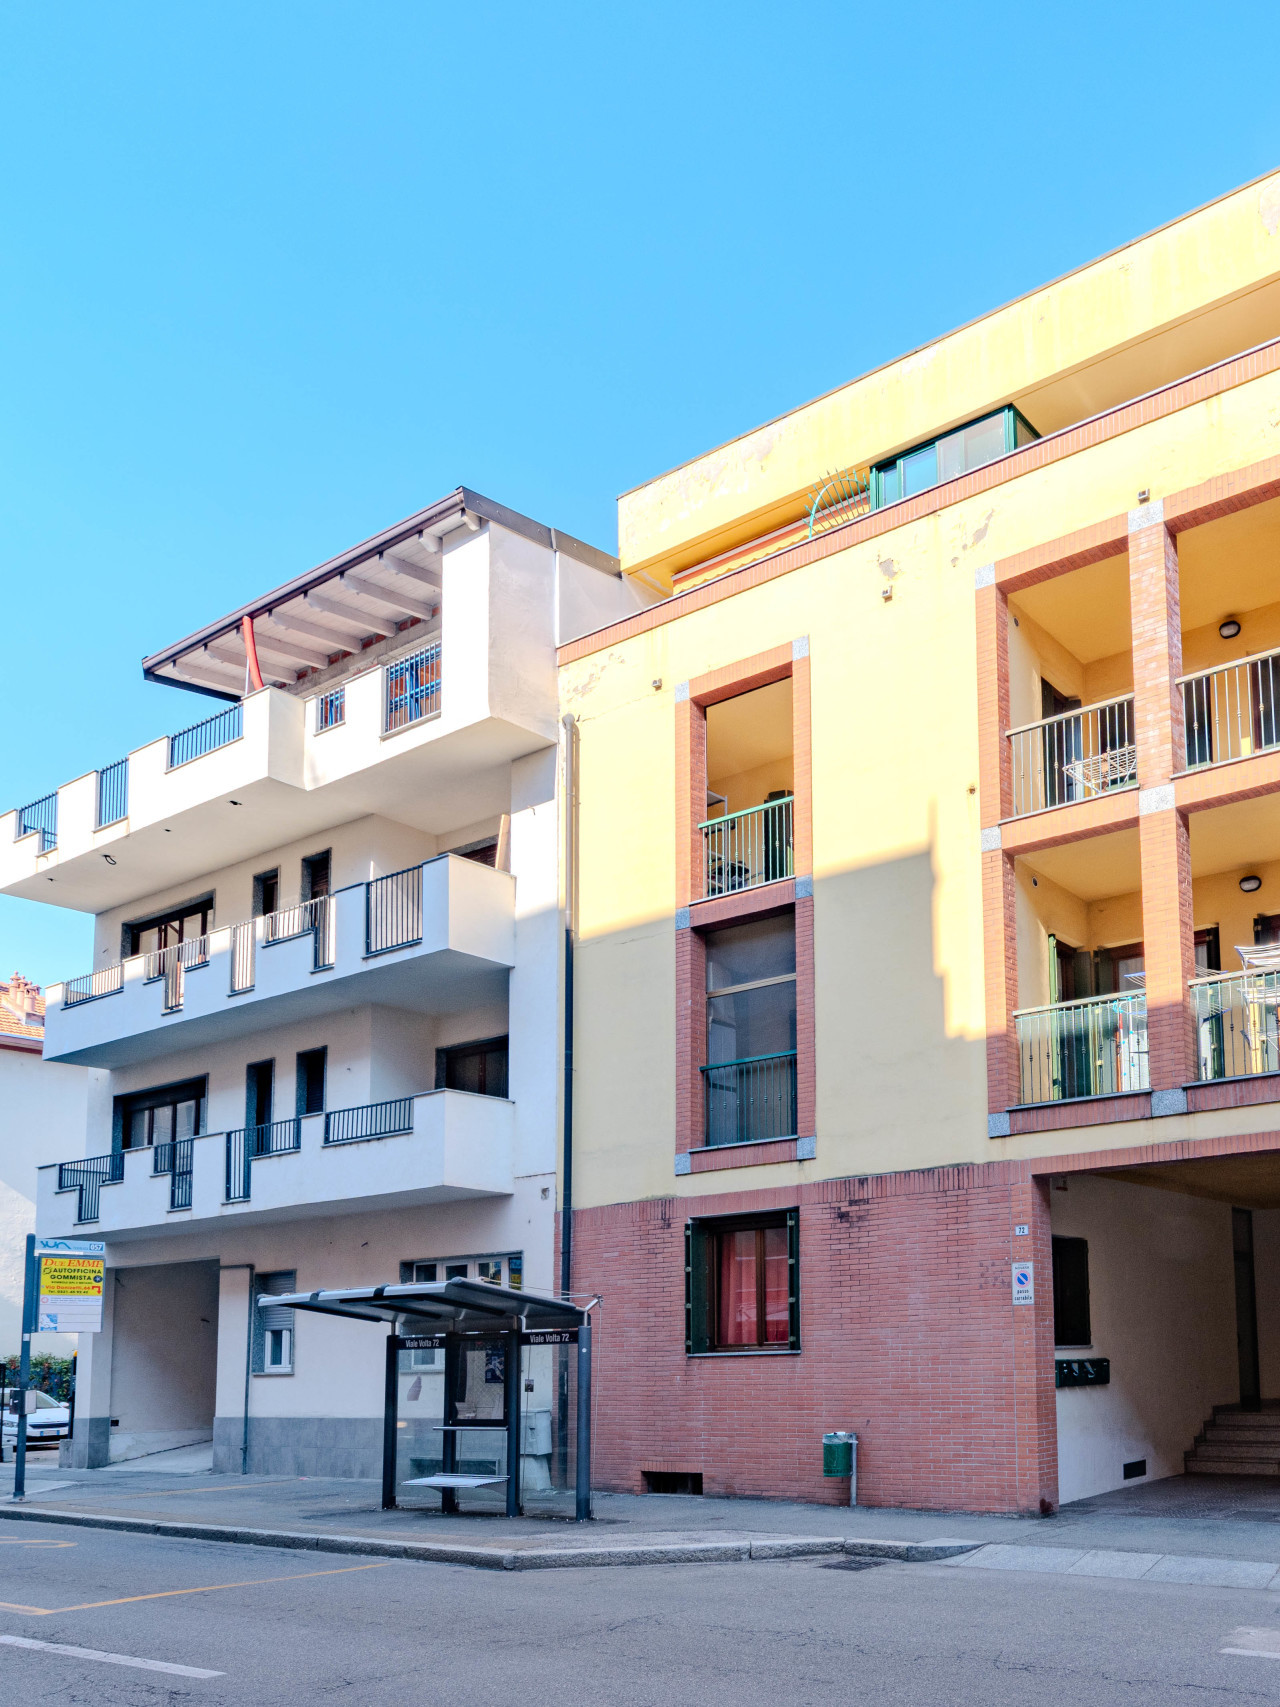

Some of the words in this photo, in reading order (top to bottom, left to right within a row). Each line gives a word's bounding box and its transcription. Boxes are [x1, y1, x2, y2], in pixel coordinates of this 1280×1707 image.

[1018, 1226, 1025, 1234] 72
[530, 1334, 544, 1343] Viale
[545, 1332, 561, 1342] Volta
[562, 1333, 570, 1341] 72
[405, 1339, 418, 1348] Viale
[419, 1338, 431, 1347] Volta
[432, 1338, 439, 1346] 72
